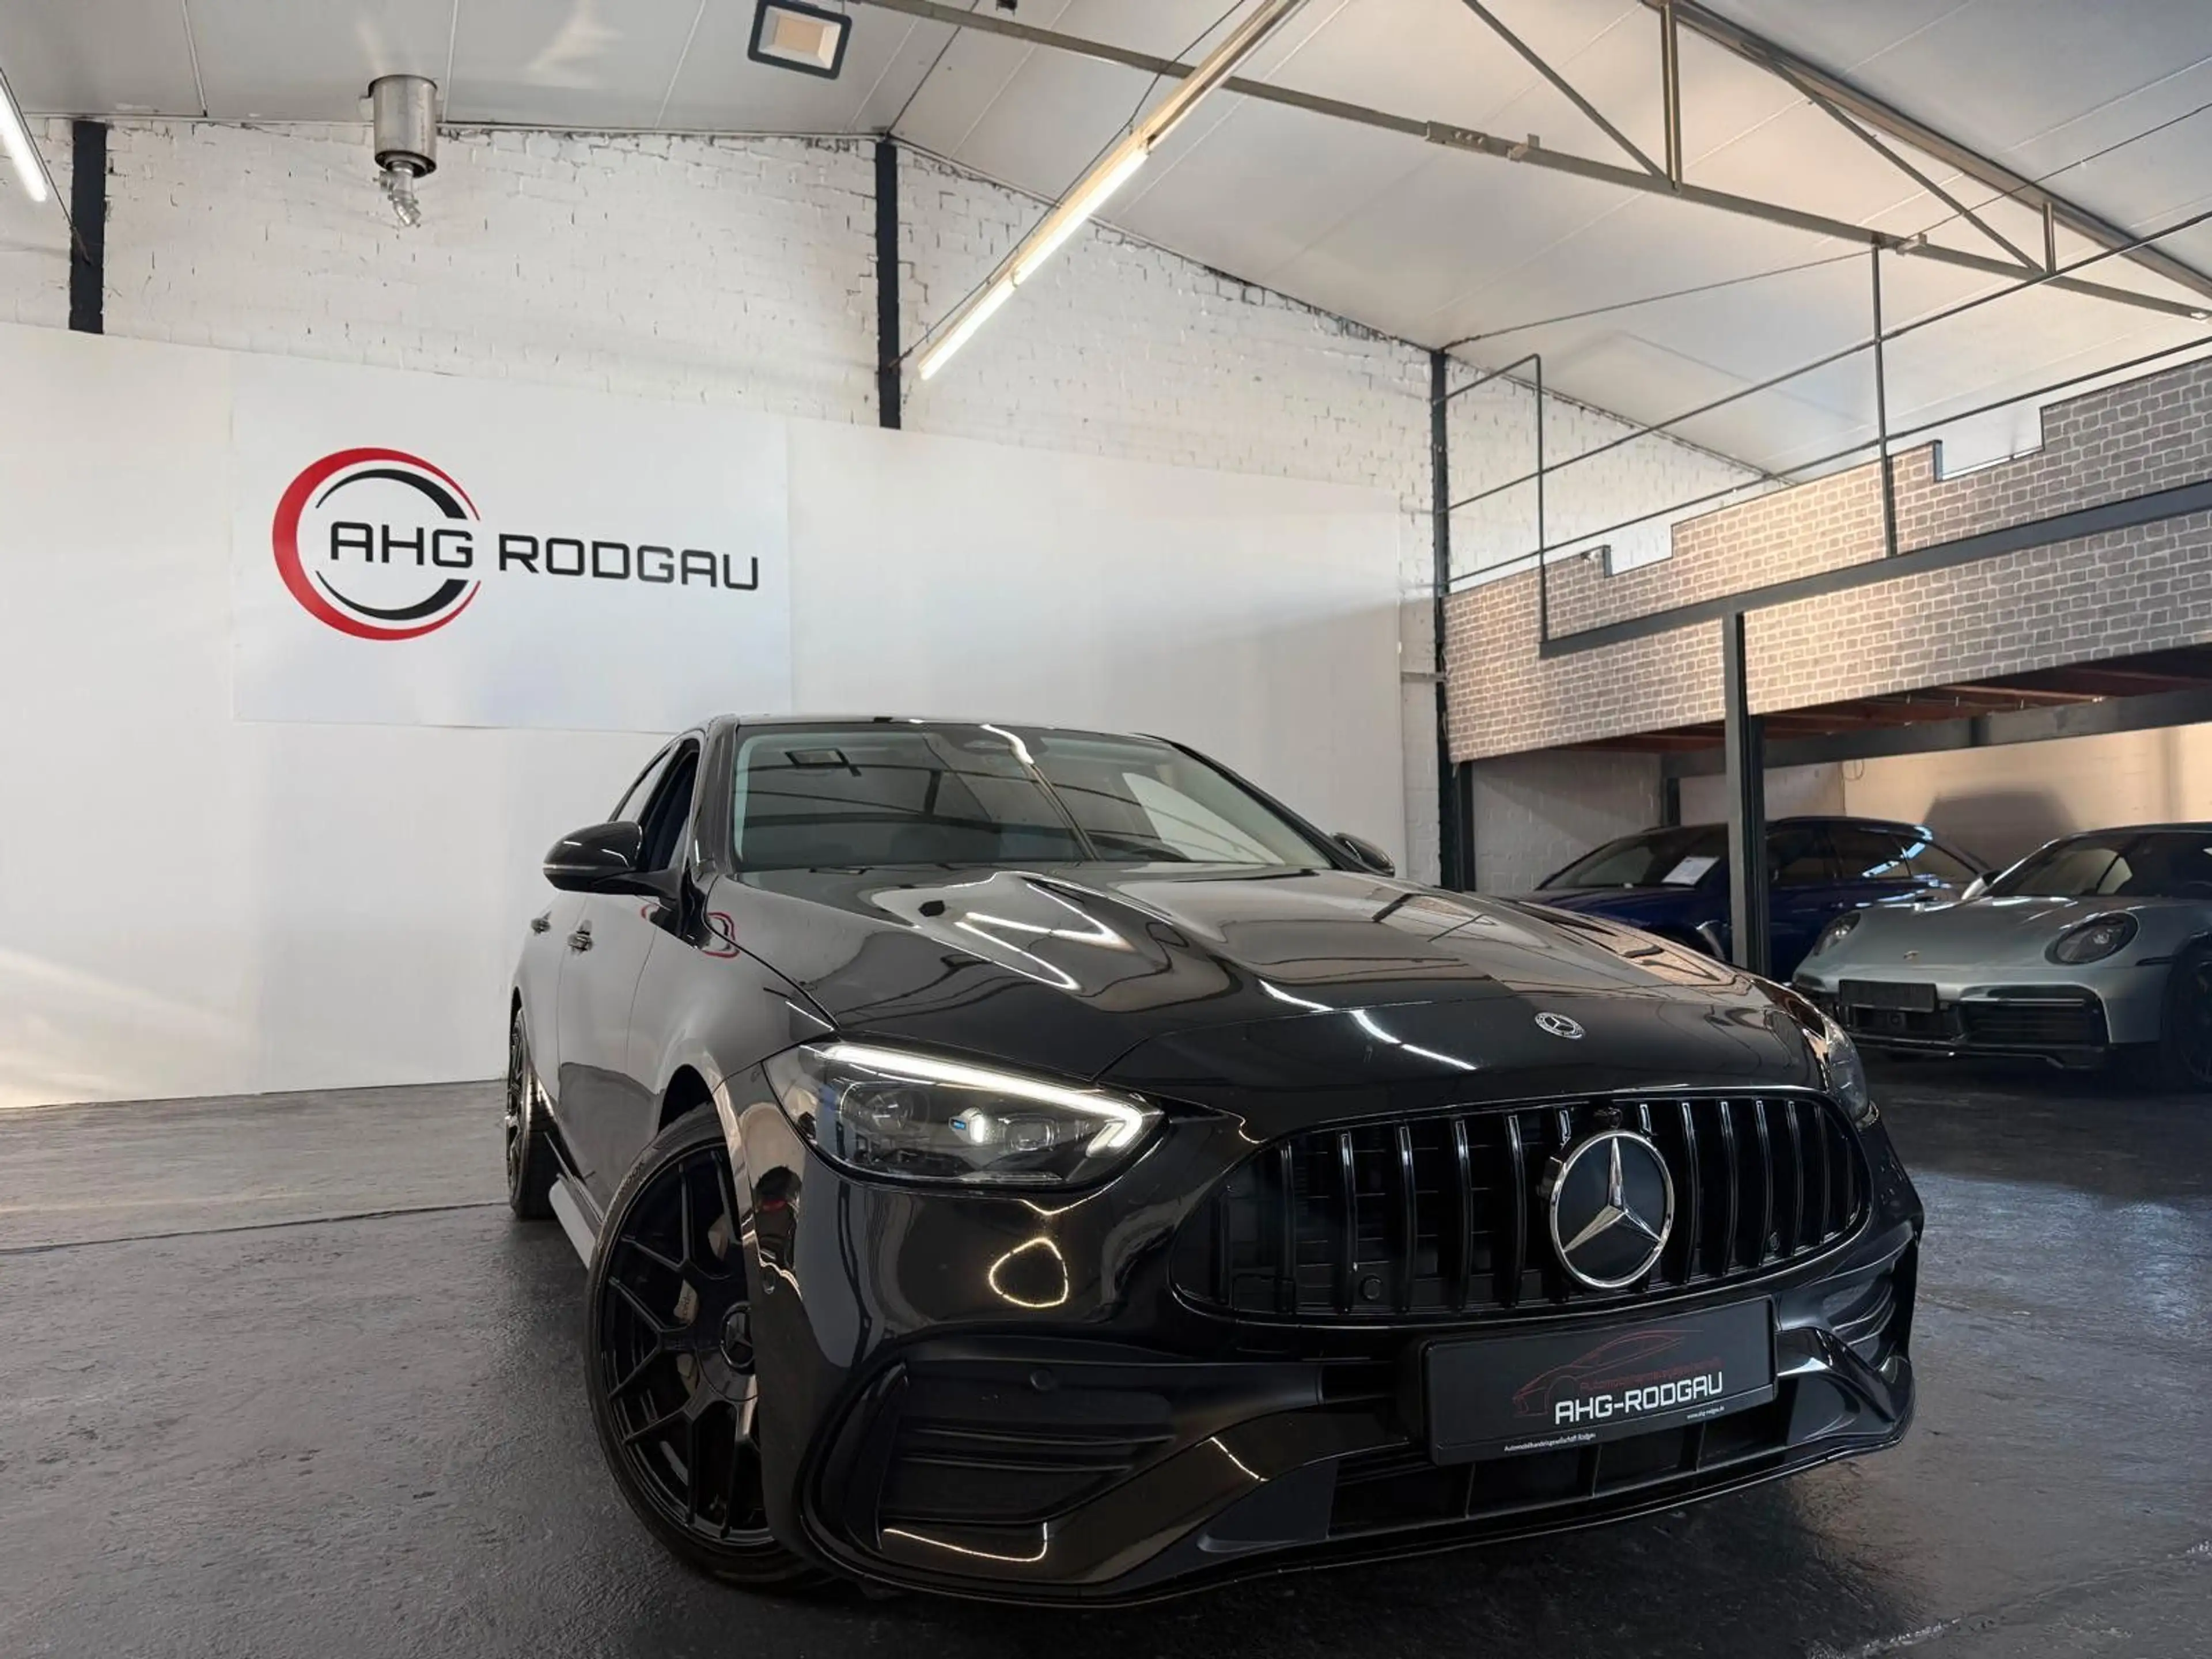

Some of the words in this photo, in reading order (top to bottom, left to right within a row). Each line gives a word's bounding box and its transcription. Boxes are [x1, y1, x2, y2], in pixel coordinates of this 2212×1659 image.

[330, 521, 473, 569] AHG
[499, 533, 759, 591] RODGAU
[1555, 1371, 1724, 1425] AHG-RODGAU
